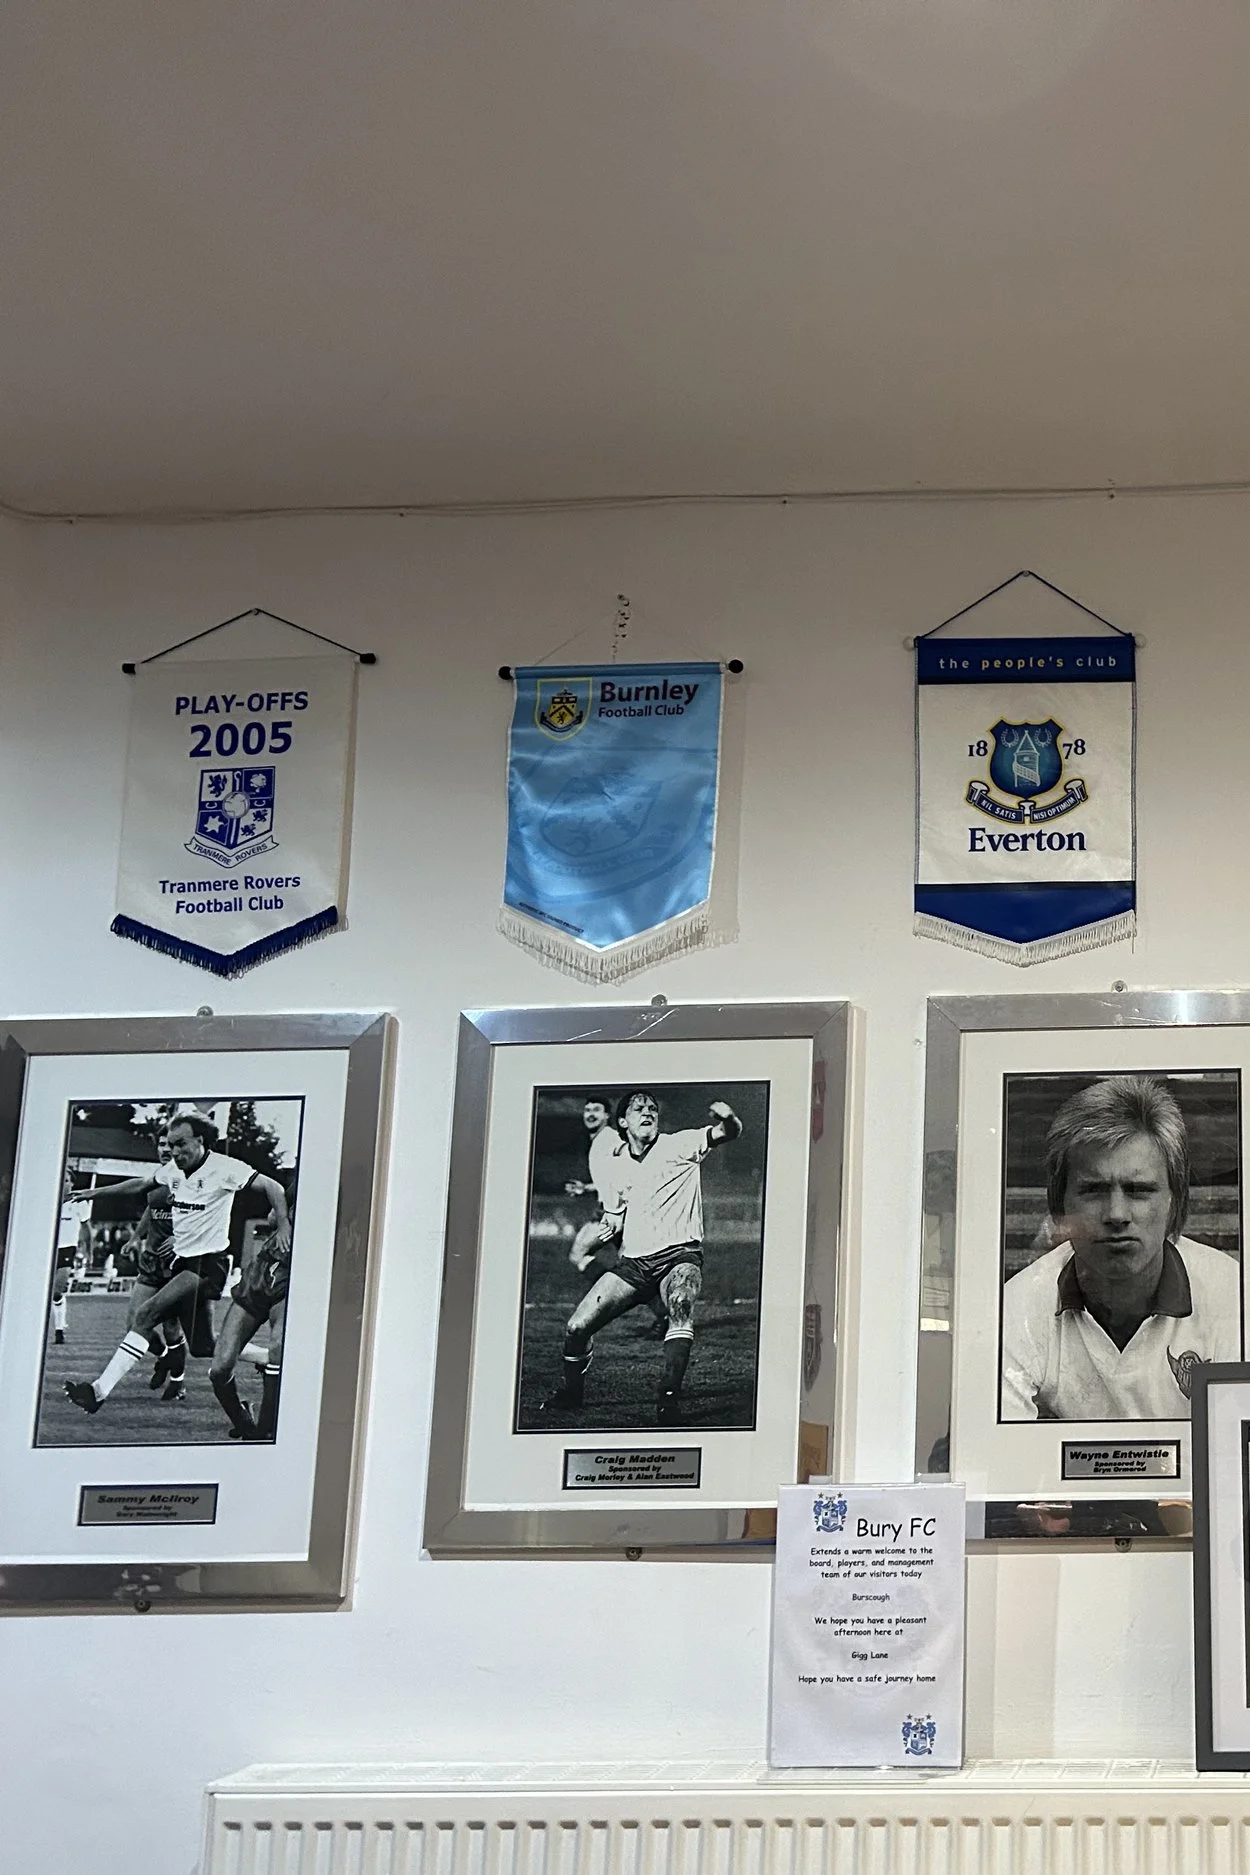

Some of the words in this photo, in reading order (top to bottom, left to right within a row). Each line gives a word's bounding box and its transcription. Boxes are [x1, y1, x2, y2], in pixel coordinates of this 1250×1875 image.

[939, 658, 970, 669] the
[981, 656, 1064, 670] people's
[1076, 656, 1117, 667] club
[600, 679, 699, 705] Burnley
[175, 691, 308, 716] PLAY-OFFS
[598, 705, 652, 718] Football
[655, 704, 684, 716] Club
[189, 721, 292, 758] 2005
[967, 740, 988, 758] 18
[1062, 738, 1086, 760] 78
[980, 799, 992, 810] NIL
[995, 806, 1016, 820] SATIS
[1033, 811, 1047, 820] NISI
[1047, 796, 1076, 817] OPTIMUM
[968, 827, 1087, 852] Everton
[193, 843, 232, 866] TRANMERE
[234, 842, 268, 862] ROVERS
[158, 878, 238, 894] Tranmere
[244, 874, 300, 890] Rovers
[175, 897, 243, 914] Football
[248, 894, 284, 910] Club
[594, 1455, 626, 1466] Craig
[629, 1454, 676, 1464] Madden
[1070, 1450, 1110, 1462] Wayne
[1112, 1450, 1170, 1459] Entwistle
[608, 1465, 650, 1474] Sponsored
[652, 1464, 662, 1473] by
[1136, 1460, 1146, 1468] by
[575, 1474, 596, 1482] Craig
[635, 1472, 654, 1480] Alan
[655, 1472, 694, 1480] Eastwood
[97, 1494, 147, 1504] Sammy
[856, 1518, 902, 1542] Bury
[910, 1518, 936, 1538] FC
[810, 1548, 842, 1556] Extends
[920, 1546, 933, 1554] the
[809, 1559, 834, 1568] board,
[837, 1560, 868, 1568] players,
[871, 1558, 885, 1566] and
[888, 1558, 934, 1568] management
[842, 1570, 852, 1578] of
[869, 1570, 898, 1578] visitors
[900, 1570, 922, 1580] today
[852, 1593, 890, 1603] Burscough
[814, 1616, 827, 1624] We
[830, 1616, 848, 1626] hope
[850, 1618, 864, 1626] you
[866, 1616, 884, 1624] have
[895, 1616, 927, 1626] pleasant
[834, 1628, 872, 1636] afternoon
[874, 1628, 892, 1636] here
[894, 1628, 904, 1636] at
[851, 1652, 868, 1660] Gigg
[870, 1651, 889, 1659] Lane
[798, 1675, 818, 1684] Hope
[820, 1676, 834, 1684] you
[836, 1674, 854, 1682] have
[864, 1674, 882, 1682] safe
[884, 1675, 914, 1684] journey
[916, 1674, 936, 1682] home
